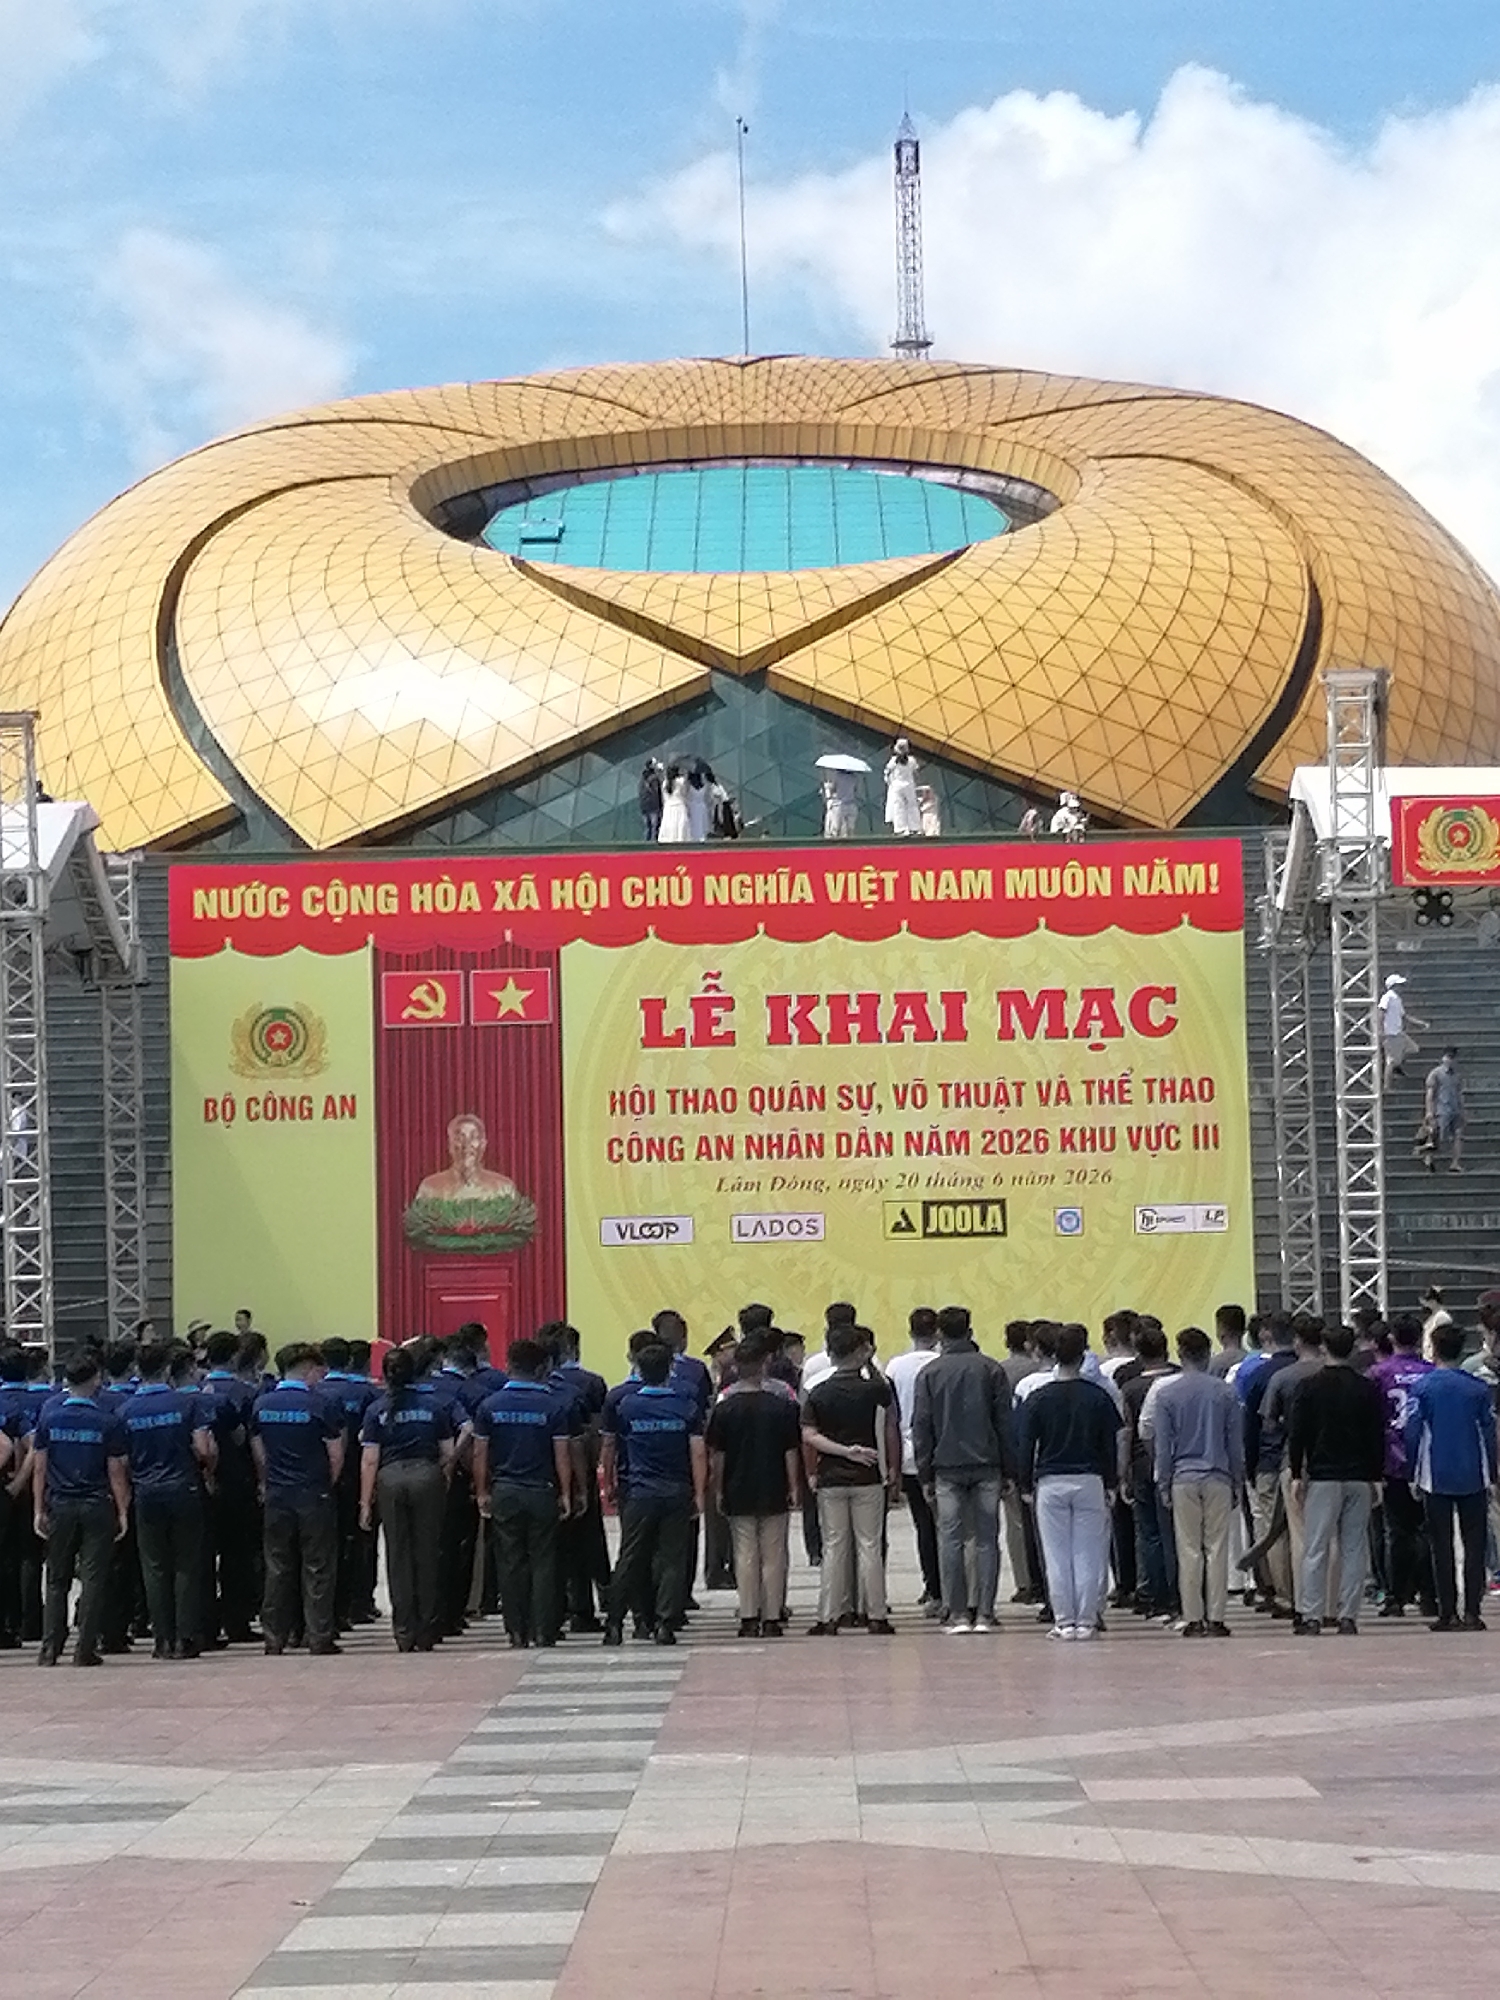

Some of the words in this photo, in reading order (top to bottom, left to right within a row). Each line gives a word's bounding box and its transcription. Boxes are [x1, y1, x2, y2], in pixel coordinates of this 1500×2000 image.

[193, 880, 290, 919] NƯỚC
[302, 878, 399, 923] CỘNG
[411, 874, 482, 914] HÒA
[492, 873, 541, 911] XÃ
[551, 872, 610, 915] HỘI
[621, 865, 693, 908] CHỦ
[704, 865, 815, 906] NGHĨA
[824, 864, 899, 910] VIỆT
[910, 869, 993, 902] NAM
[1005, 860, 1112, 899] MUÔN
[1123, 858, 1219, 897] NĂM!
[639, 970, 736, 1048] LỄ
[766, 991, 968, 1046] KHAI
[997, 985, 1178, 1051] MẠC
[204, 1091, 236, 1128] BỘ
[245, 1090, 313, 1121] CÔNG
[323, 1094, 357, 1120] AN
[609, 1083, 655, 1121] HỘI
[666, 1087, 738, 1115] THAO
[749, 1079, 826, 1116] QUÂN
[837, 1082, 883, 1117] SỰ,
[892, 1078, 928, 1110] VÕ
[937, 1076, 1027, 1114] THUẬT
[1036, 1073, 1073, 1107] VÀ
[1081, 1067, 1134, 1105] THỂ
[1143, 1077, 1215, 1104] THAO
[607, 1131, 685, 1163] CÔNG
[695, 1134, 735, 1161] AN
[745, 1127, 825, 1160] NHÂN
[836, 1126, 893, 1158] DÂN
[904, 1124, 971, 1156] NĂM
[981, 1128, 1049, 1155] 2026
[1059, 1126, 1116, 1153] KHU
[1126, 1122, 1181, 1158] VỰC
[1192, 1123, 1220, 1151] III
[716, 1175, 761, 1193] Lâm
[839, 1174, 889, 1193] ngày
[895, 1172, 919, 1189] 20
[925, 1172, 984, 1192] tháng
[993, 1172, 1004, 1187] 6
[1011, 1170, 1056, 1187] năm
[1064, 1169, 1112, 1186] 2026
[738, 1218, 819, 1238] LADOS
[926, 1204, 1004, 1233] JOOLA
